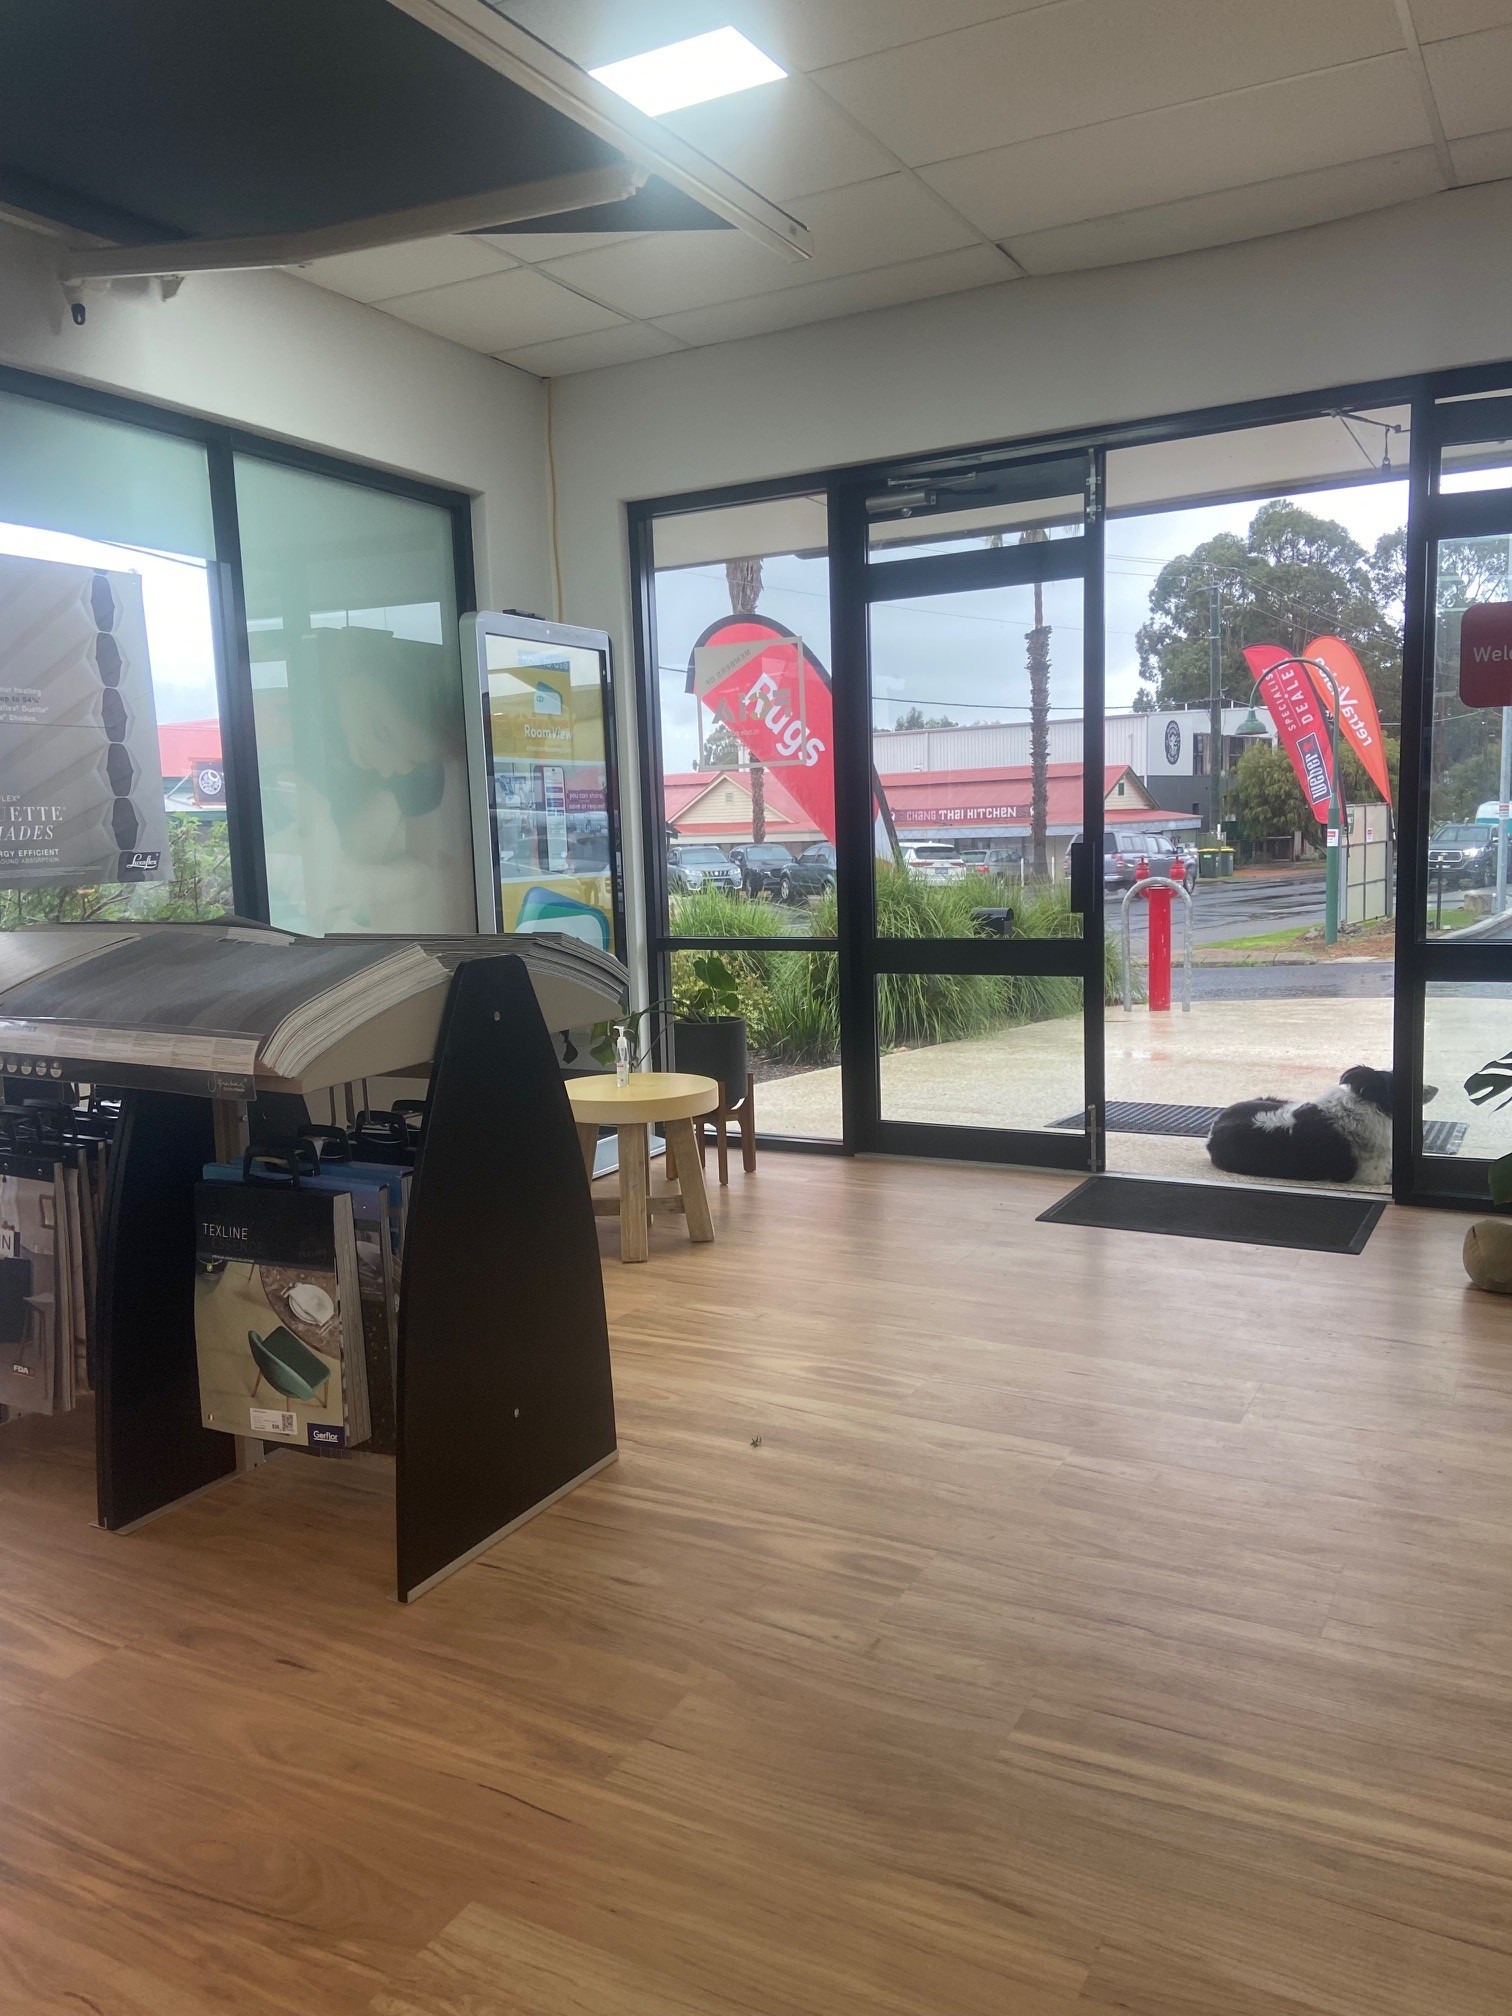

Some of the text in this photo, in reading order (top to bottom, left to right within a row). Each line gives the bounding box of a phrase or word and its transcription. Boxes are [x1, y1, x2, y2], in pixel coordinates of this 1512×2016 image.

[1472, 644, 1512, 663] Wel
[743, 672, 826, 768] Rugs
[0, 824, 54, 841] ADES
[18, 848, 60, 857] EFFICIENT
[203, 1223, 248, 1240] TEXLINE
[313, 1430, 338, 1441] Gerflor
